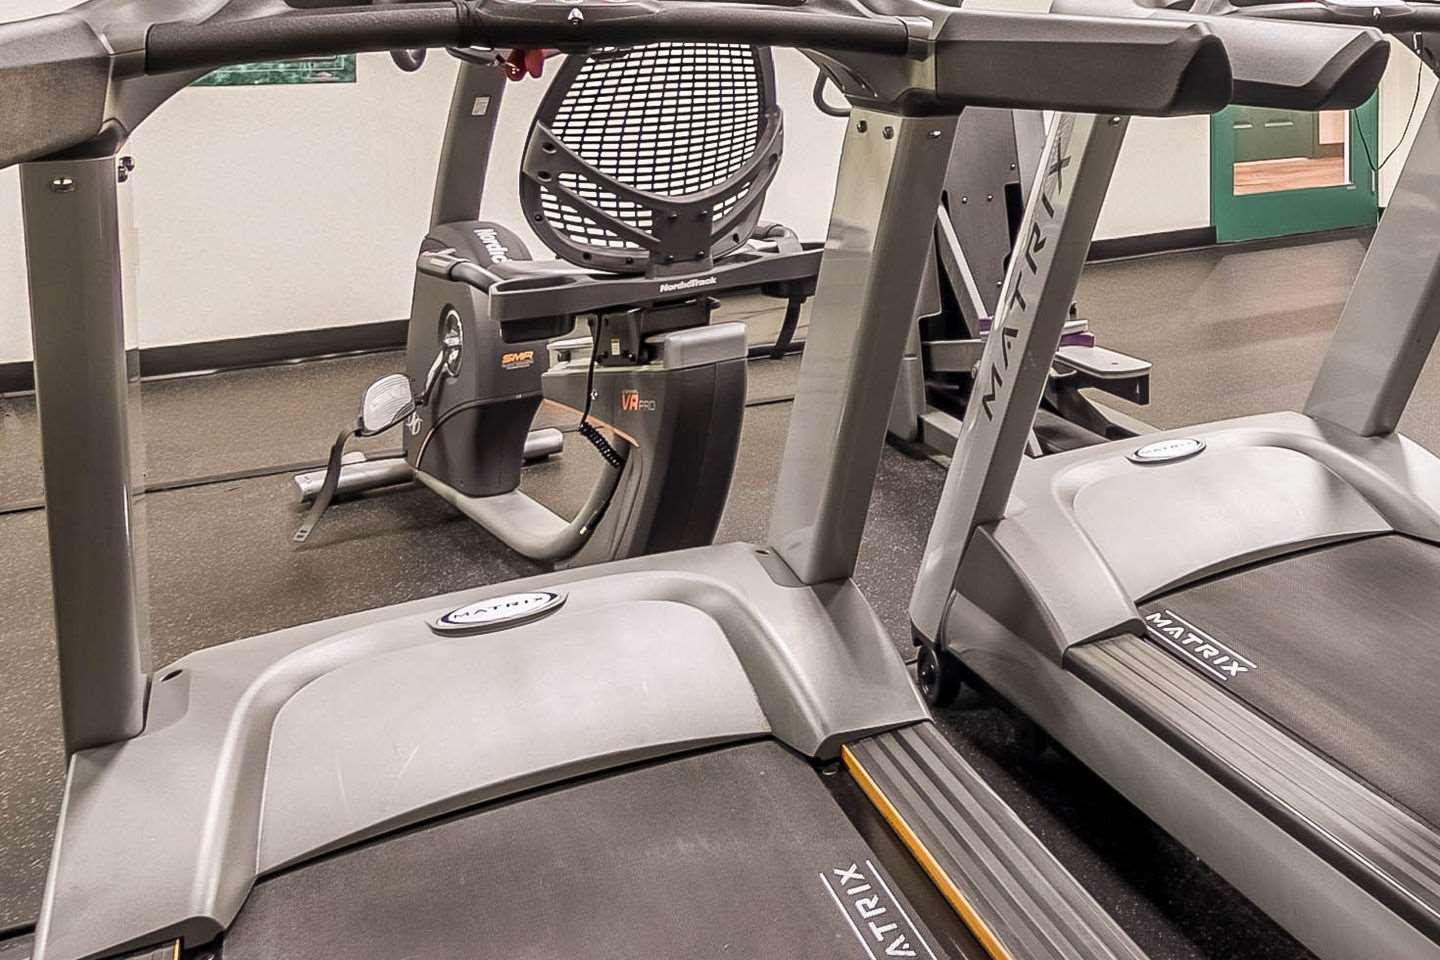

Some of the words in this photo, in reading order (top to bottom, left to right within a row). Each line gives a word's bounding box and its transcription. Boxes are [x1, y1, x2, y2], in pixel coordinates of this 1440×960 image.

[473, 227, 510, 265] Nordic
[982, 136, 1072, 422] MATRIX
[659, 276, 718, 293] NordicTrack
[1144, 611, 1250, 678] MATRIX
[832, 862, 918, 958] ATRIX
